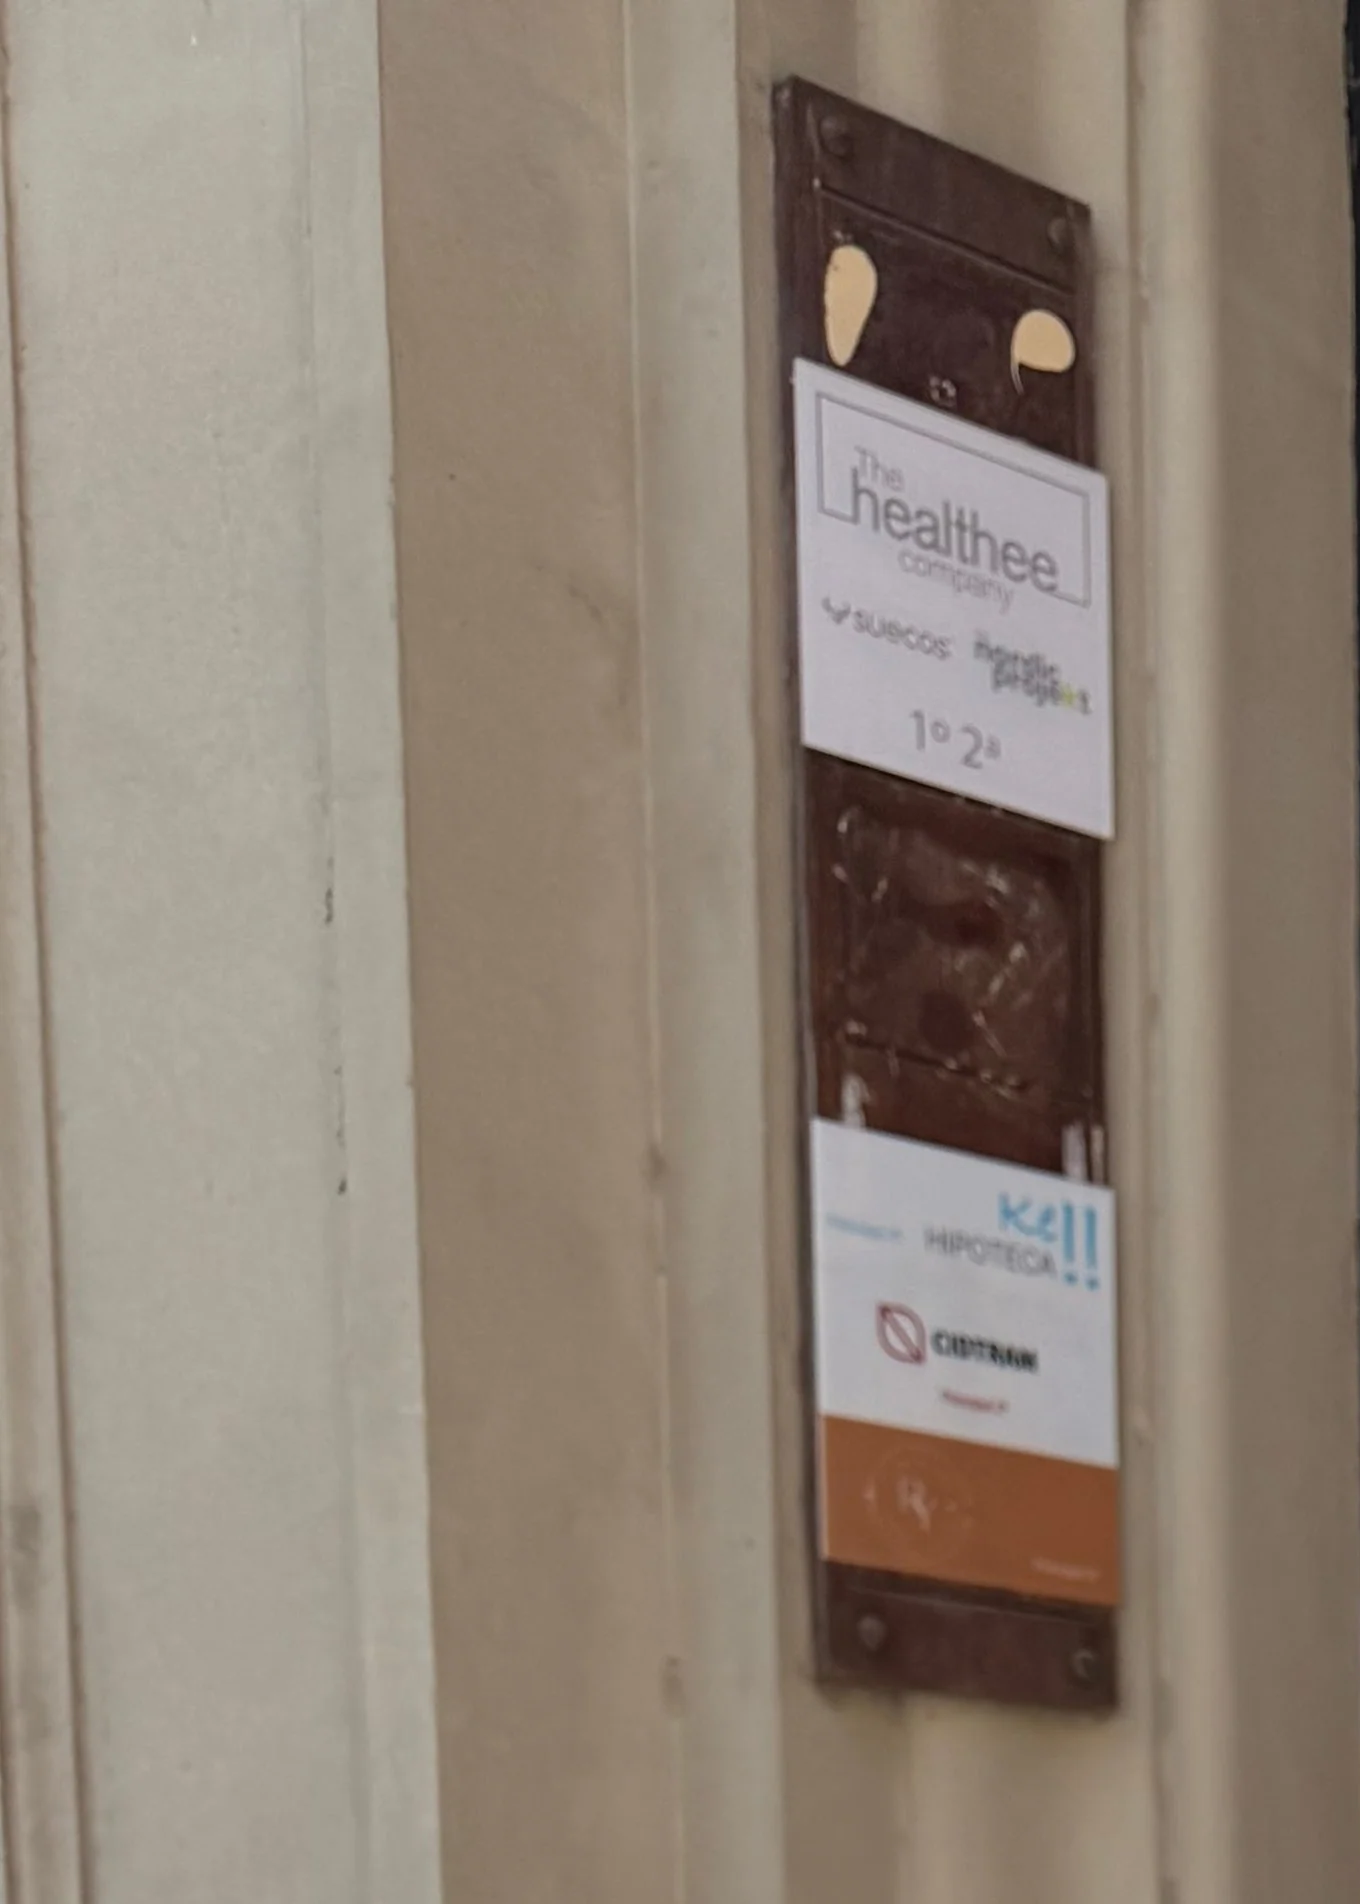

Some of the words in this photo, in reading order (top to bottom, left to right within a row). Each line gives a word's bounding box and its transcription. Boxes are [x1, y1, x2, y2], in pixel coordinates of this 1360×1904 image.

[853, 445, 906, 493] The
[851, 466, 1060, 593] healthee
[898, 549, 1014, 616] company
[923, 1224, 1058, 1280] HIPOTECA
